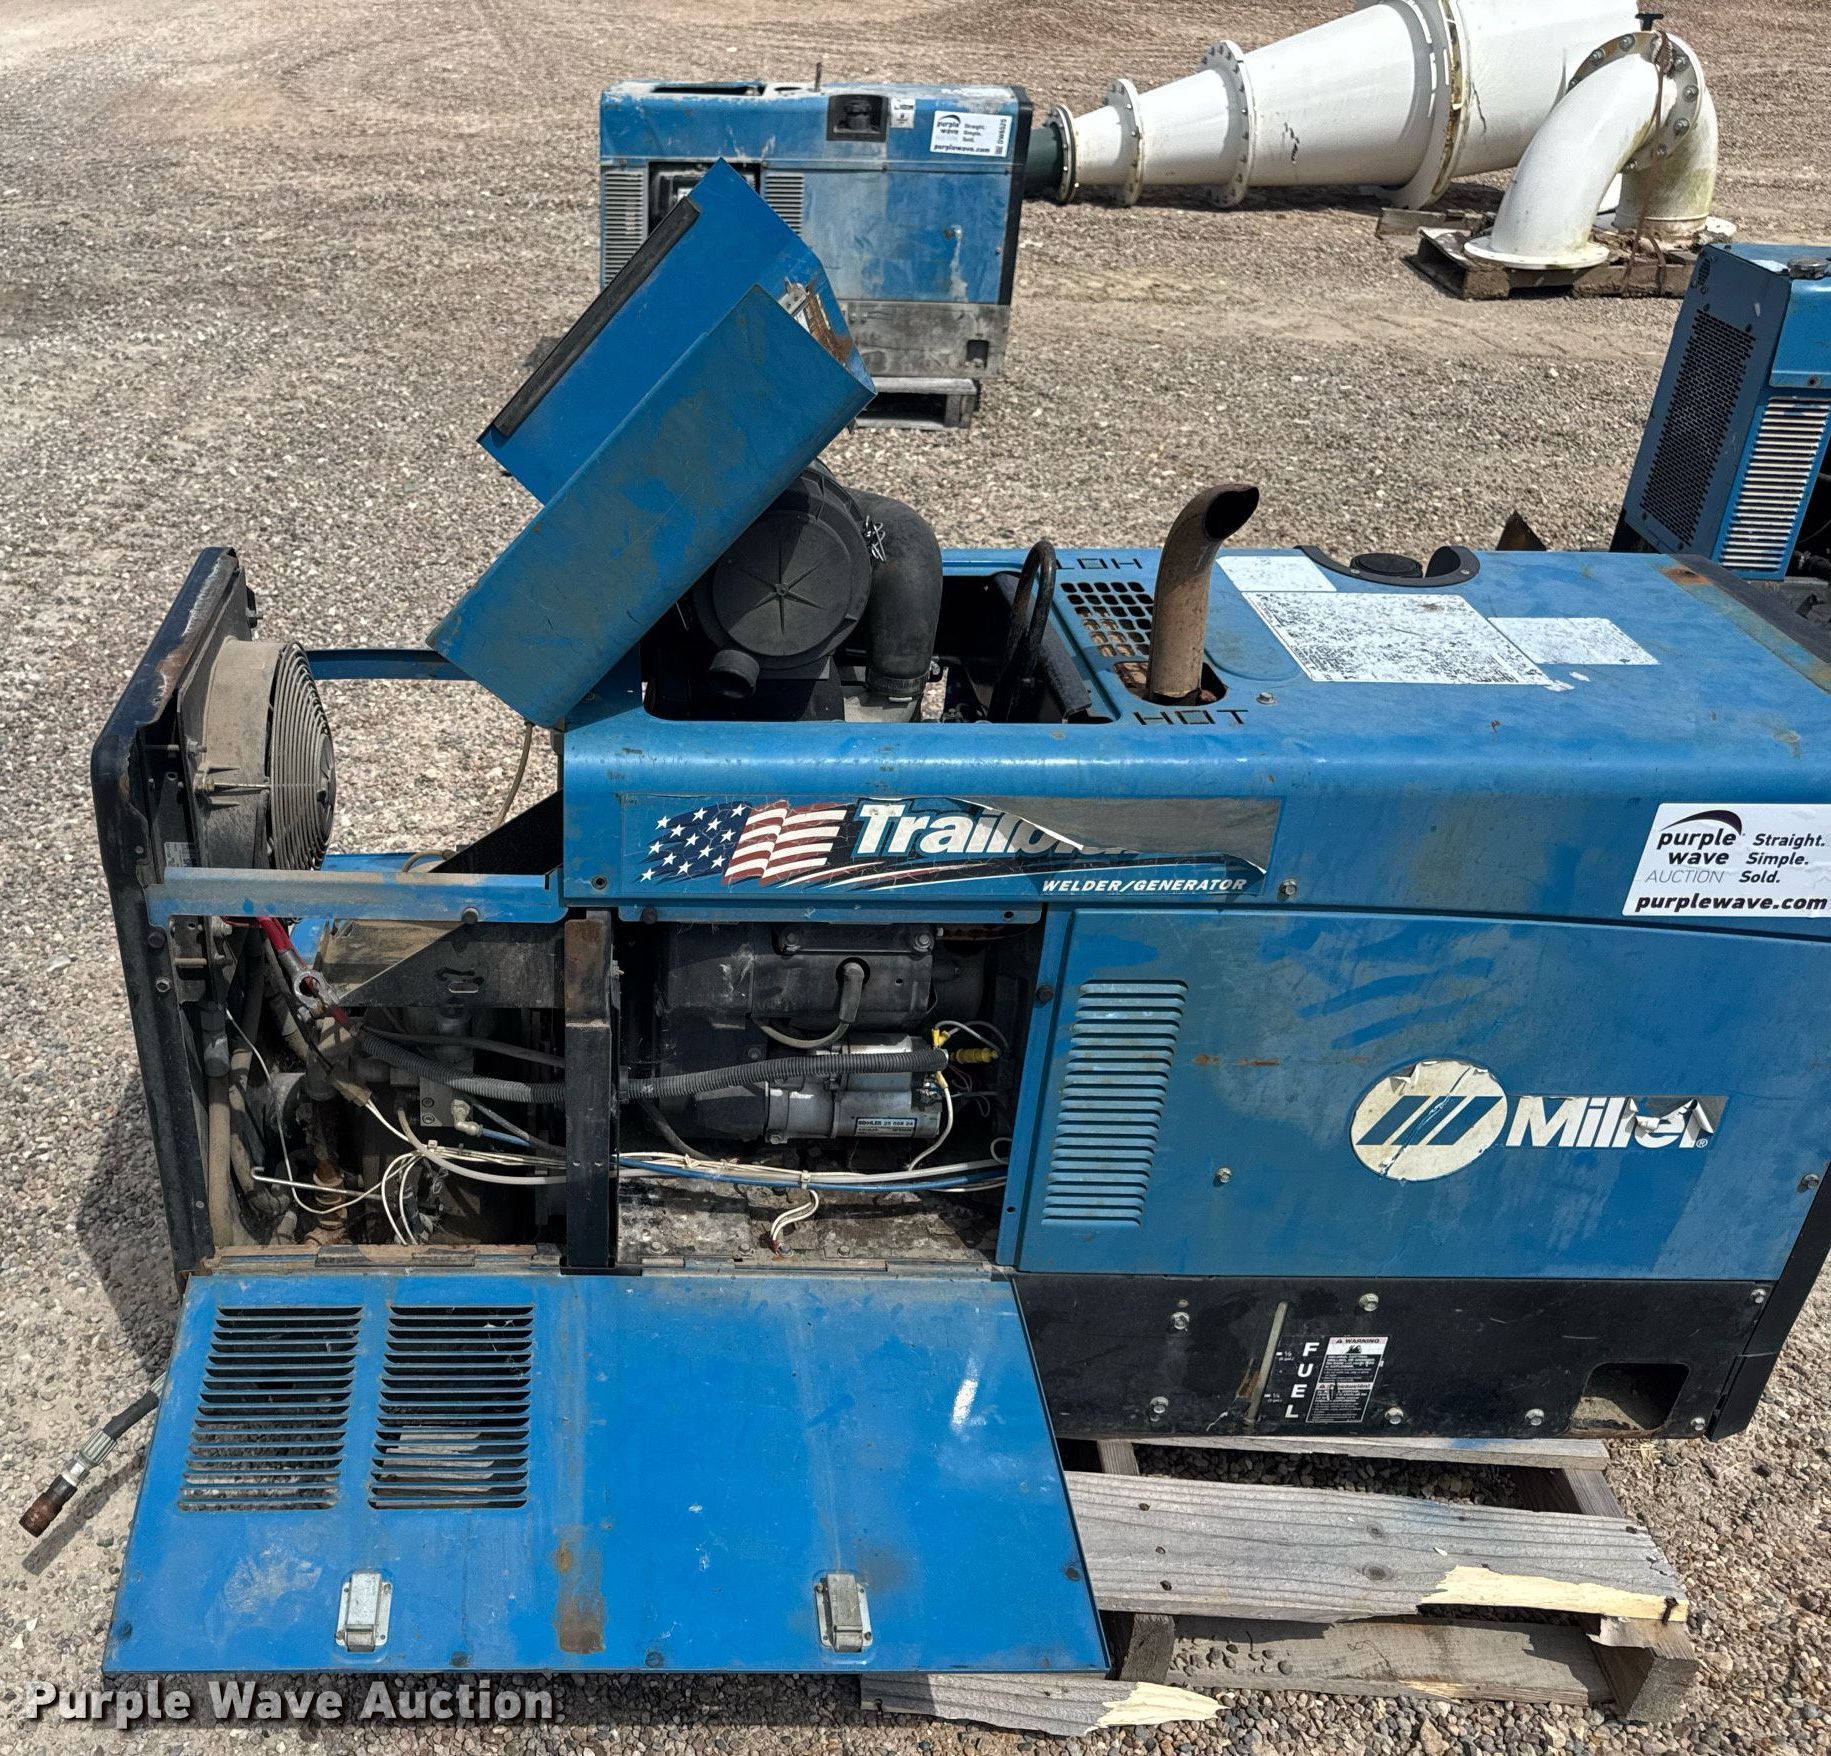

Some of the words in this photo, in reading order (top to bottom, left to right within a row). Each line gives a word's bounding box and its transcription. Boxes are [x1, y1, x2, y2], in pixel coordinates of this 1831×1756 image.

[1134, 709, 1249, 726] HOT
[1656, 828, 1737, 850] purple
[1752, 833, 1826, 849] Straight.
[1668, 851, 1730, 865] wave
[1745, 852, 1809, 868] Simple.
[1645, 869, 1725, 884] AUCTION
[1738, 870, 1781, 884] Sold.
[1042, 877, 1249, 893] WELDER/GENERATOR
[1635, 893, 1828, 913] purplewave.com
